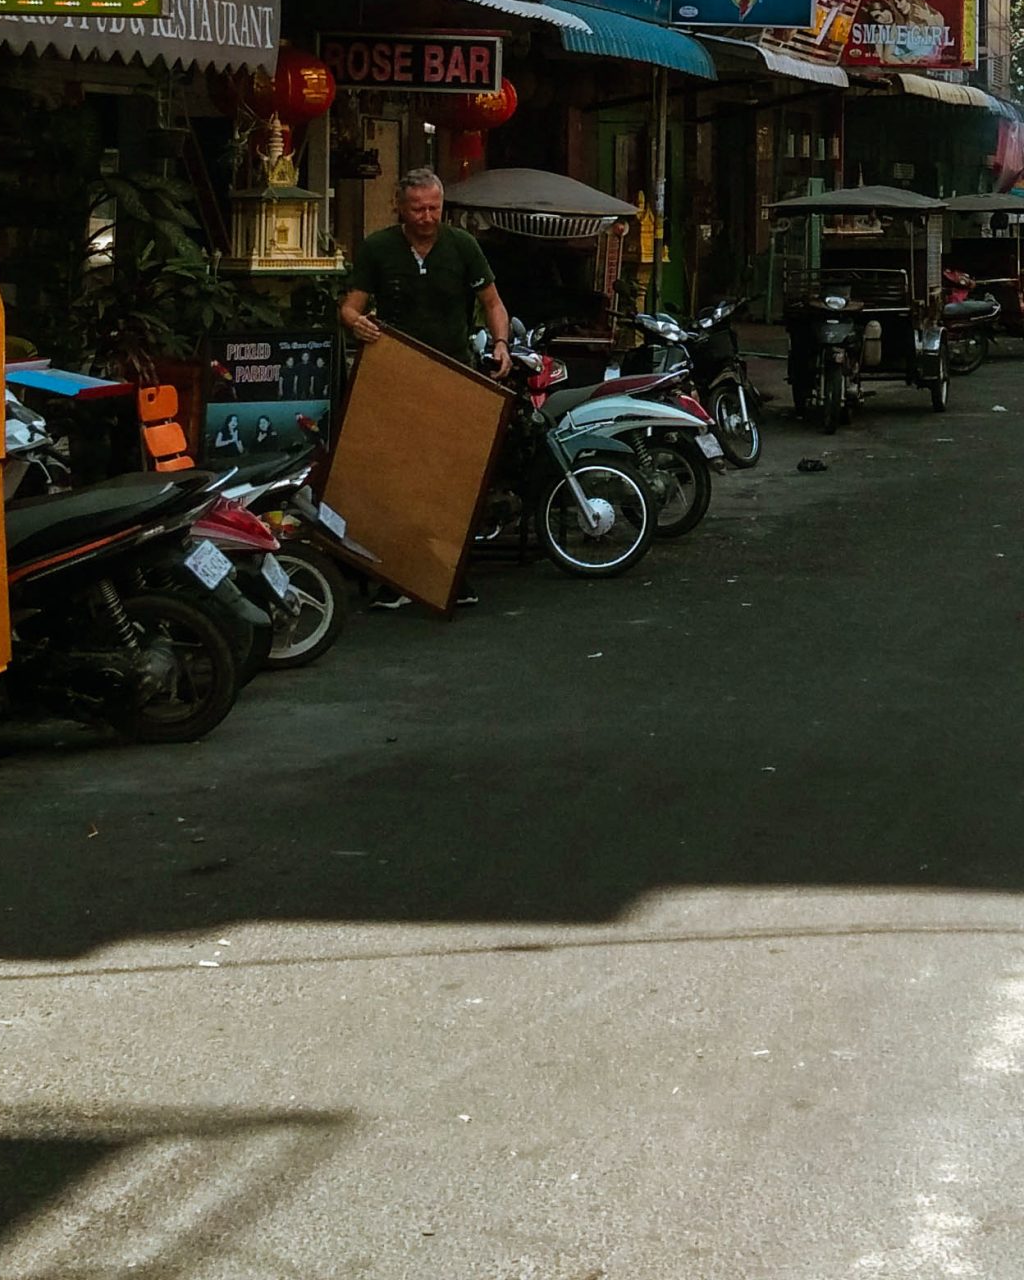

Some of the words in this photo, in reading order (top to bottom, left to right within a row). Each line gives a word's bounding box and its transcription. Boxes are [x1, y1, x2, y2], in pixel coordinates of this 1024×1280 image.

[327, 42, 414, 82] ROSE
[424, 44, 491, 83] BAR
[235, 364, 281, 383] PARROT
